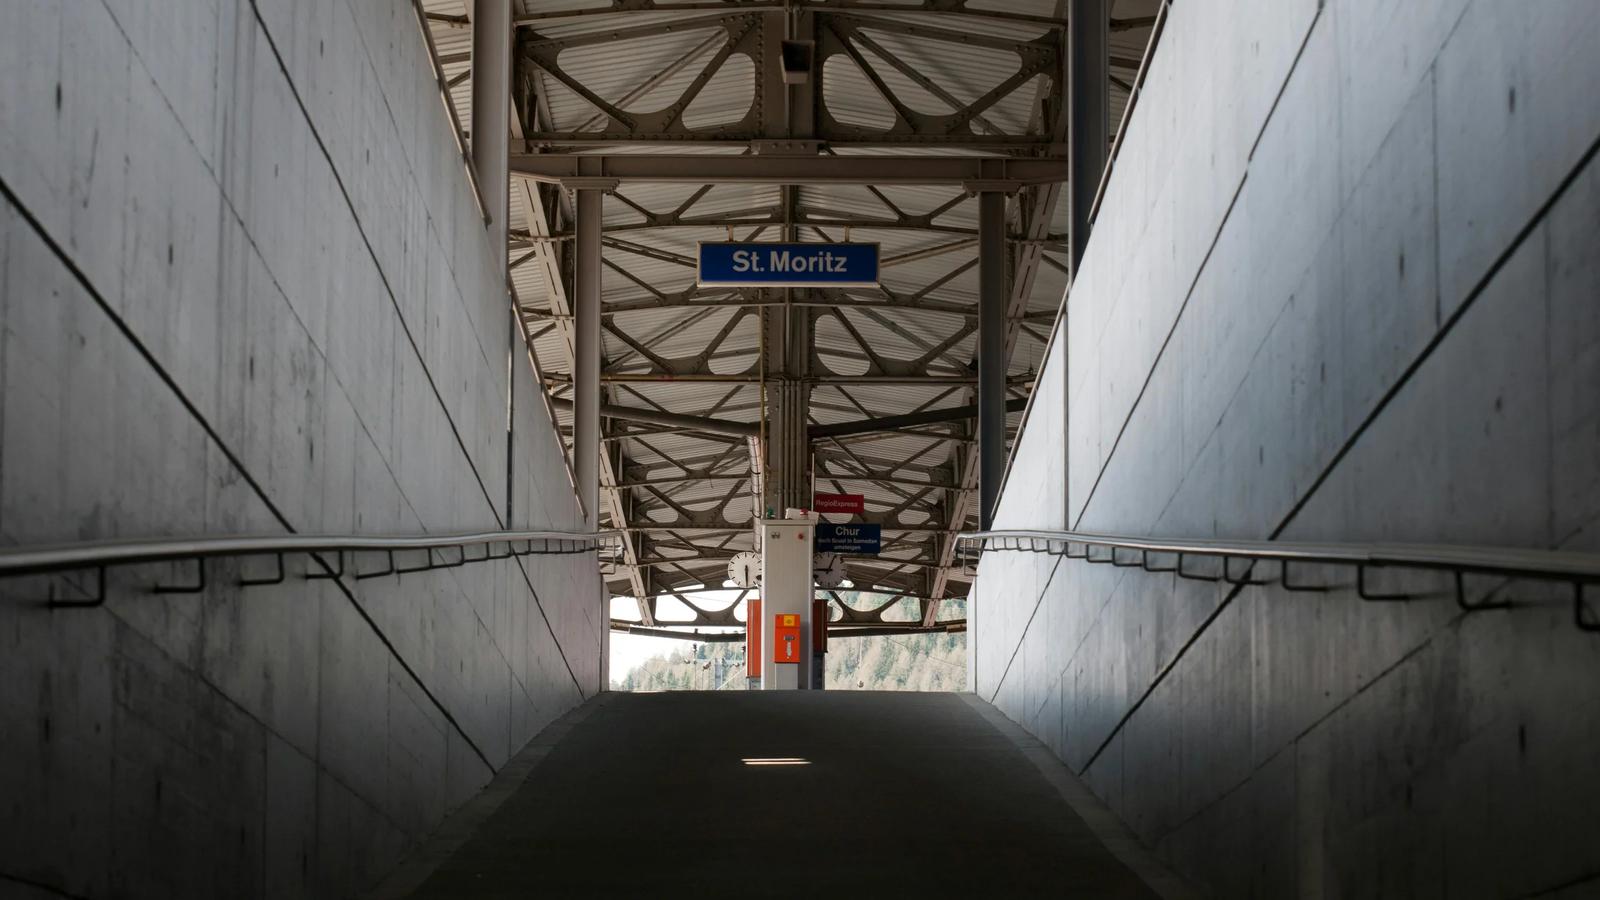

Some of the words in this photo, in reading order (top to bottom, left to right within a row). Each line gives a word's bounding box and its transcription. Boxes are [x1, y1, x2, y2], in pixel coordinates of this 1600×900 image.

[732, 250, 765, 272] St.
[770, 250, 848, 272] Moritz
[835, 526, 861, 536] Chur
